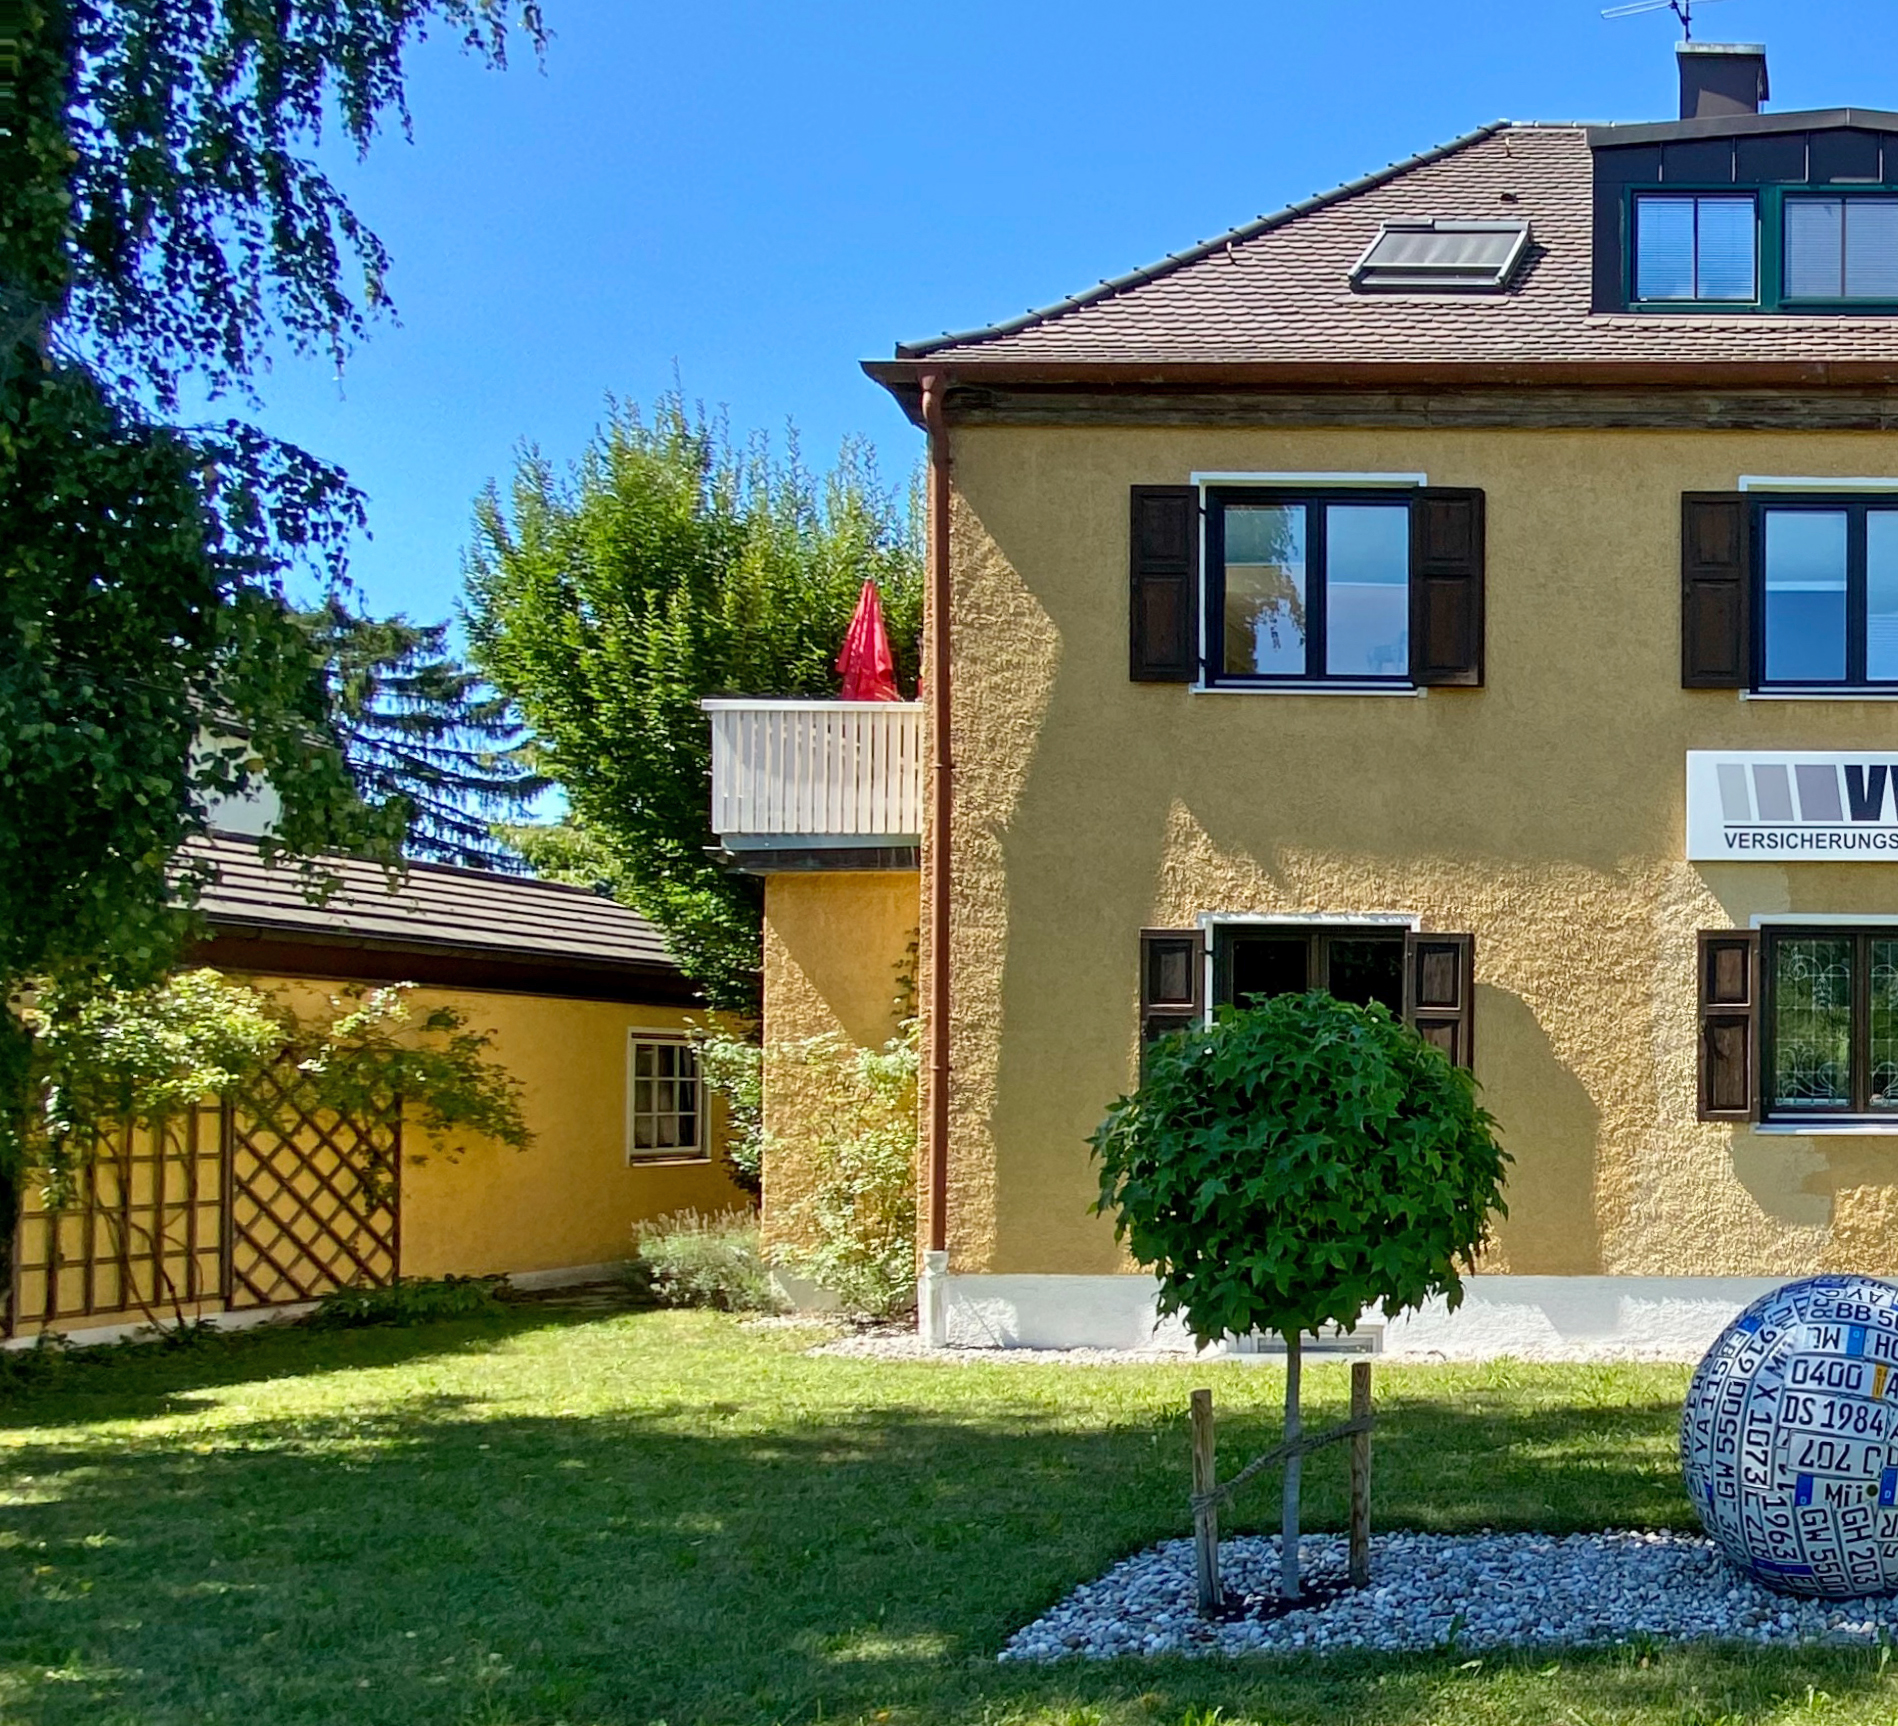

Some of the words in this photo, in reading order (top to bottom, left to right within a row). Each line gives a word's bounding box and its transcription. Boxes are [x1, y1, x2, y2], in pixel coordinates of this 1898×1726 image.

[1836, 1302, 1871, 1321] BB
[1716, 1381, 1747, 1455] 5500
[1782, 1394, 1816, 1426] DS
[1819, 1400, 1883, 1438] 1984
[1716, 1460, 1736, 1499] GW
[1761, 1494, 1799, 1561] 1963
[1848, 1546, 1881, 1585] 203
